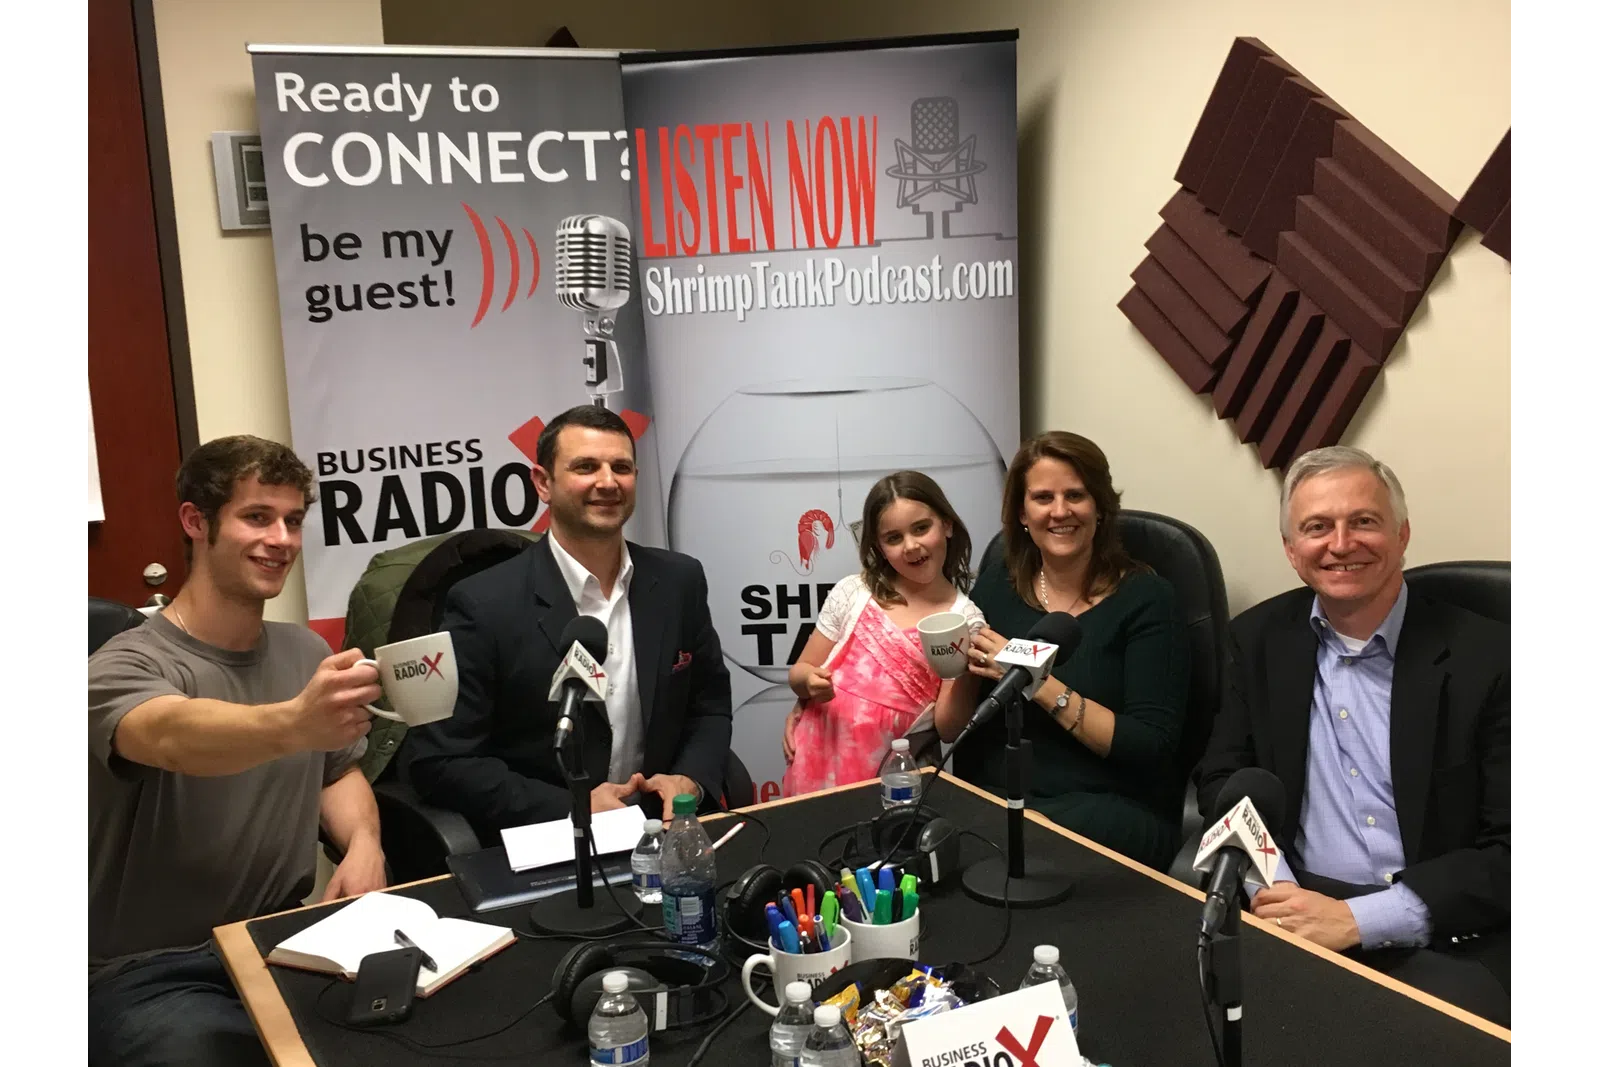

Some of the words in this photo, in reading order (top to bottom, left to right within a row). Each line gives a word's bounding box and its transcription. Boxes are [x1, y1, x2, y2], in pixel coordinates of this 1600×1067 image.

[275, 72, 431, 122] Ready
[449, 77, 499, 112] to
[283, 130, 631, 187] CONNECT?
[635, 120, 775, 257] LISTEN
[786, 115, 878, 249] NOW
[300, 223, 362, 262] be
[382, 228, 454, 275] my
[305, 270, 456, 323] guest!
[646, 254, 1014, 322] ShrimpTankPodcast.com
[317, 438, 483, 476] BUSINESS
[922, 1041, 987, 1067] BUSINESS
